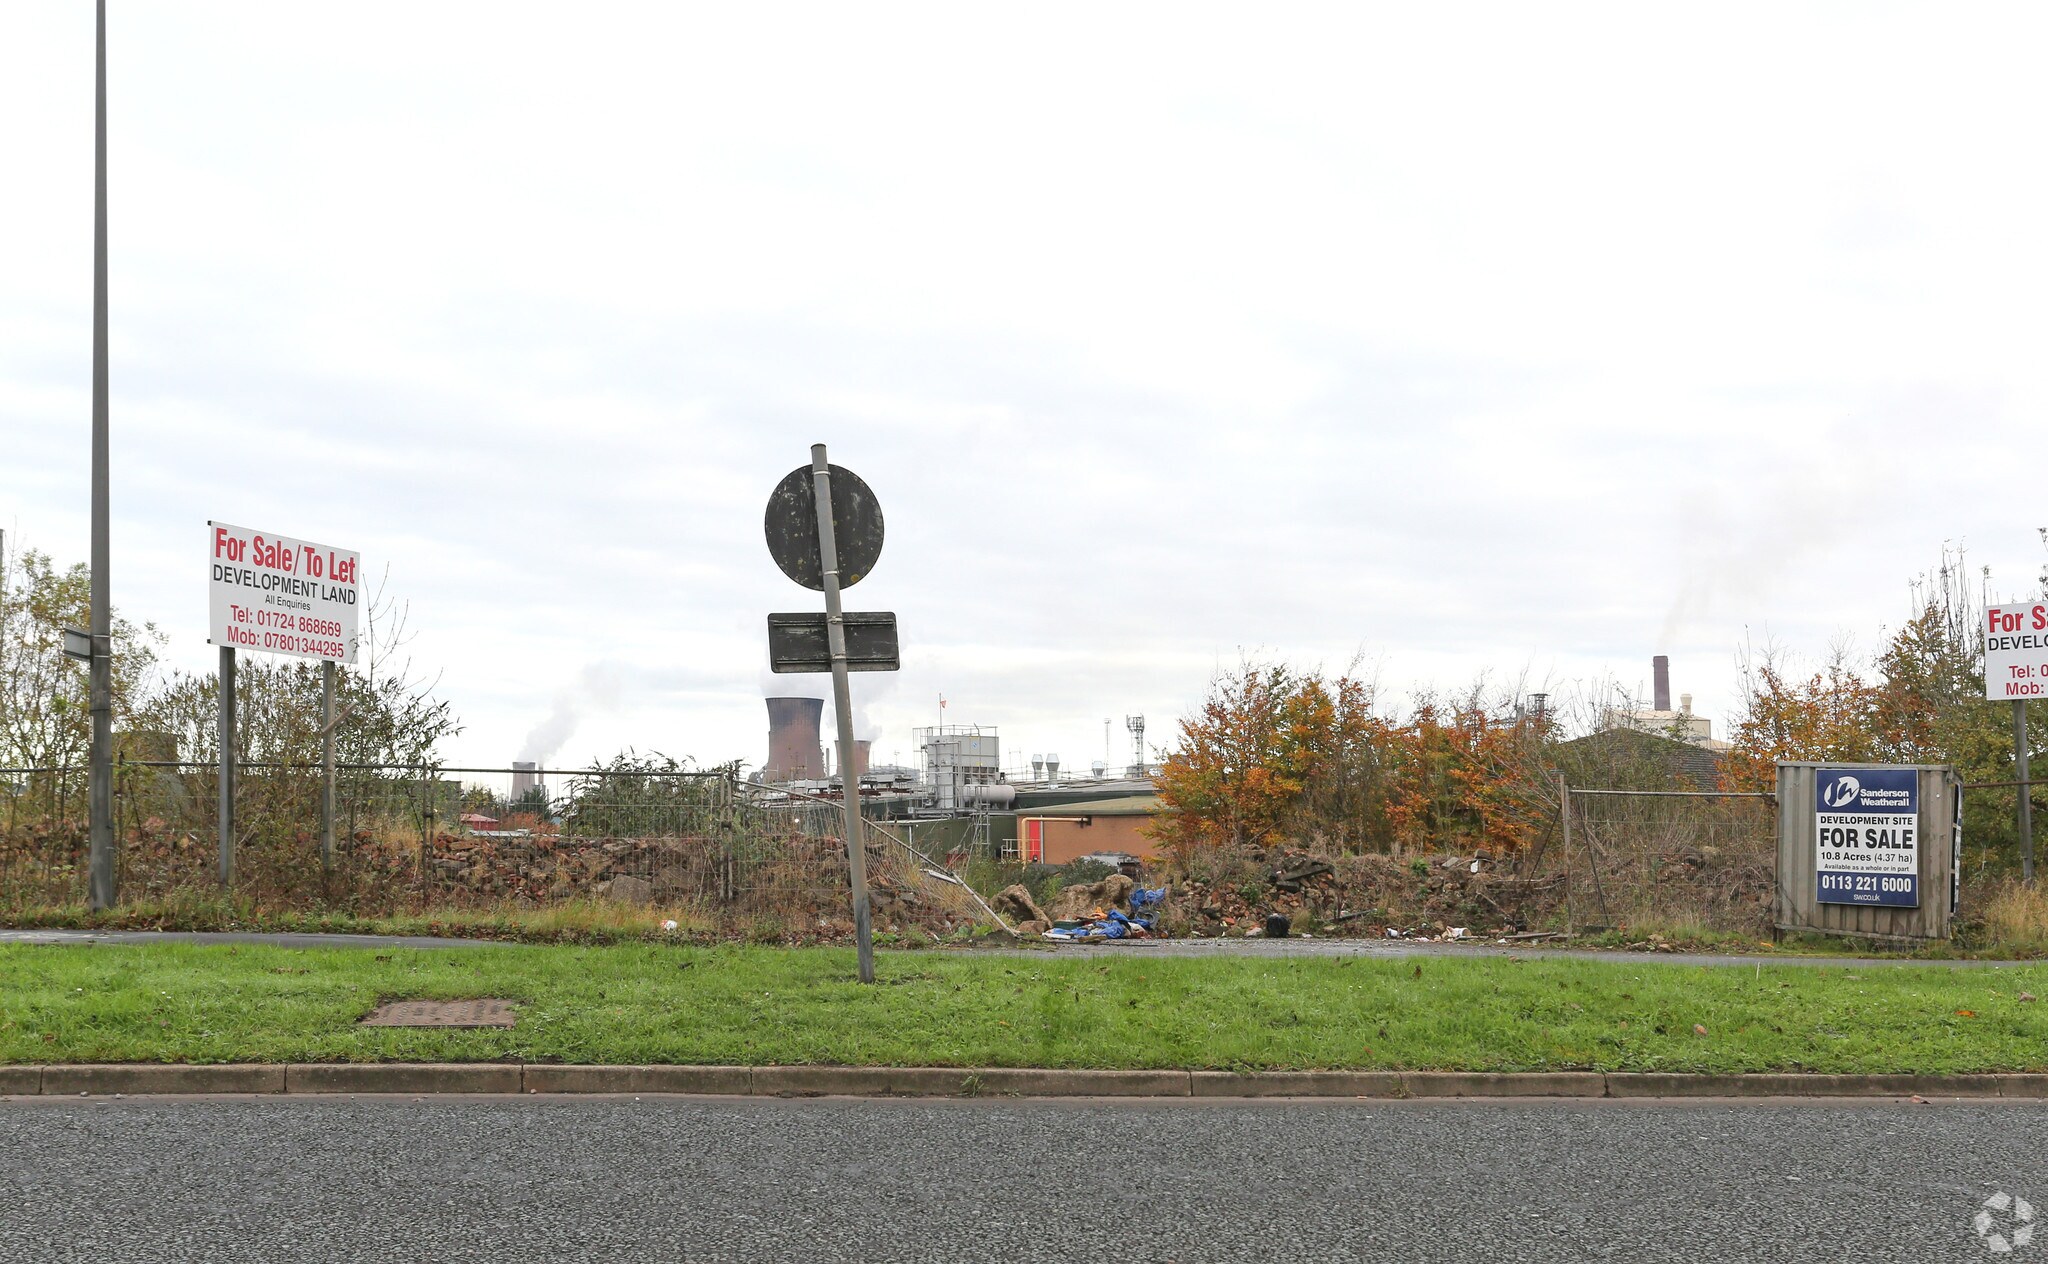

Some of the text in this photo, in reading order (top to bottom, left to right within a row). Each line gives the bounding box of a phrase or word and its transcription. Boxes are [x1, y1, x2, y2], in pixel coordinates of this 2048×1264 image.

[216, 527, 247, 562] For
[329, 551, 356, 584] Let
[213, 564, 356, 605] DEVELOPMENT LAND
[265, 594, 311, 611] All Enquiries
[230, 604, 341, 637] Tel: 01724 868669
[1988, 605, 2048, 633] For S
[227, 625, 344, 658] Mob: 07801344295
[2008, 664, 2035, 679] Tel:
[2005, 681, 2044, 696] Mob:
[1860, 789, 1909, 797] Sanderson
[1860, 798, 1909, 806] Weatherall
[1820, 815, 1913, 826] DEVELOPMENT SITE
[1820, 827, 1913, 850] FOR SALE
[1821, 851, 1913, 864] 10.8 Acres (4.37 ha)
[1822, 874, 1912, 892] 0113 221 6000
